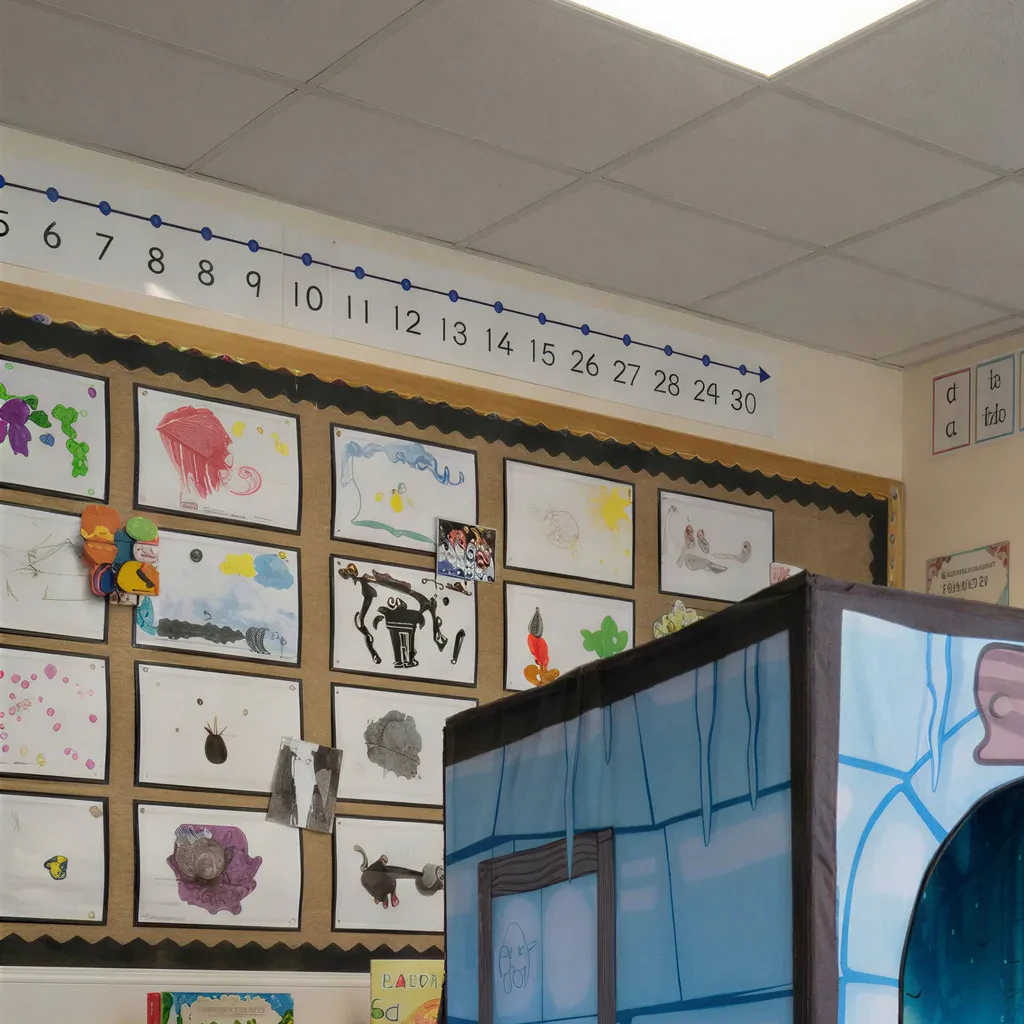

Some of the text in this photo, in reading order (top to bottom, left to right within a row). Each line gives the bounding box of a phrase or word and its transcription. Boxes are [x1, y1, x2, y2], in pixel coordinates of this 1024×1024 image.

[43, 221, 62, 249] 6
[96, 232, 114, 260] 7
[147, 247, 165, 274] 8
[198, 260, 215, 286] 8
[246, 271, 262, 297] 9
[294, 282, 323, 311] 10
[348, 295, 369, 324] 11
[394, 305, 421, 335] 12
[441, 317, 468, 345] 13
[486, 328, 514, 356] 14
[530, 339, 556, 366] 15
[571, 350, 599, 376] 26
[613, 360, 641, 386] 27
[654, 370, 680, 396] 28
[693, 379, 720, 405] 24
[731, 389, 757, 414] 30
[946, 420, 957, 438] a
